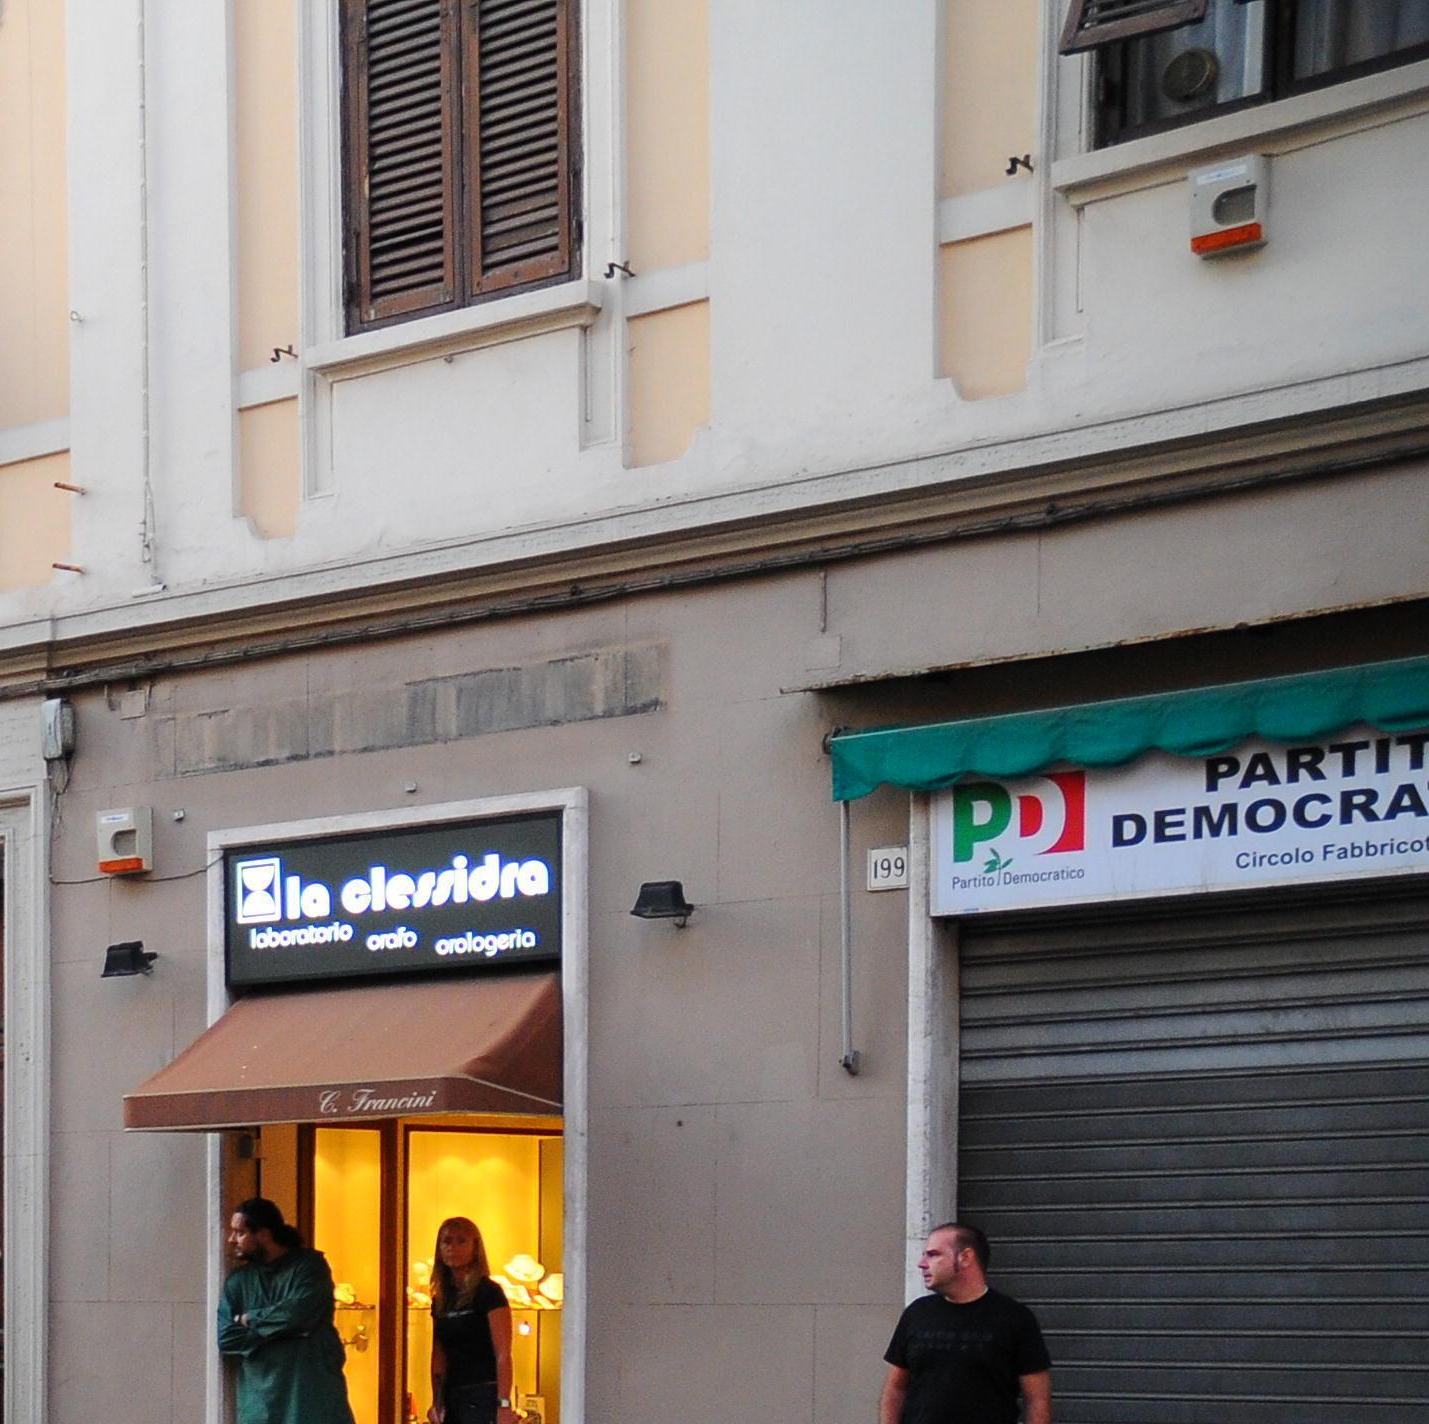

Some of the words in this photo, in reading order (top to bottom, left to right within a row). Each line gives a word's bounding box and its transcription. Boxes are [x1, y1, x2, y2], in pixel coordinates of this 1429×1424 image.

[1111, 783, 1429, 848] DEMOCRA
[873, 856, 905, 880] 199
[1235, 848, 1314, 870] Circolo
[285, 874, 331, 920] la
[341, 852, 550, 915] clessidra
[951, 873, 995, 890] Partito
[1003, 866, 1085, 886] Democratico
[250, 922, 354, 950] laboratorio
[365, 925, 418, 951] orafo
[434, 928, 536, 958] orologeria
[347, 1088, 438, 1113] Francini
